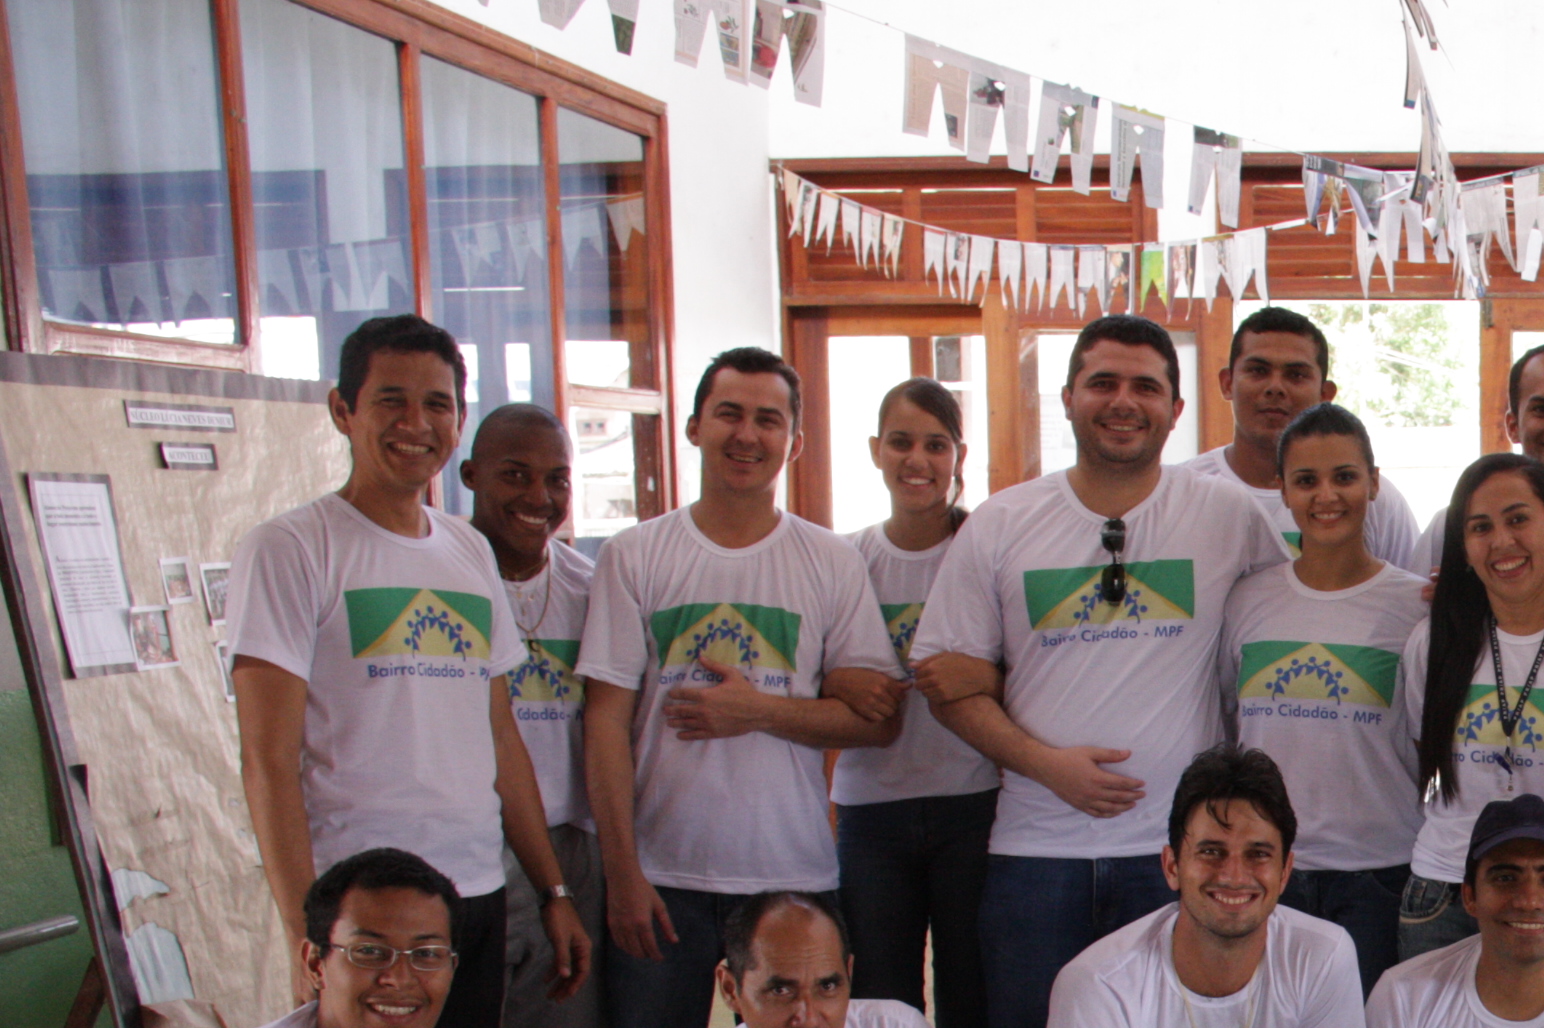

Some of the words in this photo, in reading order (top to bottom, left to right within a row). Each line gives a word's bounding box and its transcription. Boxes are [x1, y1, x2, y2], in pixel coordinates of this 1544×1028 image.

[1041, 634, 1076, 648] Bairro
[1081, 626, 1138, 642] Cidadão
[1154, 625, 1184, 638] MPF
[368, 663, 416, 678] Bairro
[418, 662, 465, 678] Cidadão
[659, 670, 686, 685] airr
[692, 668, 749, 685] Cidao
[764, 674, 791, 688] MPF
[517, 707, 565, 721] Cdadão
[1242, 703, 1273, 717] Bairro
[1278, 703, 1338, 720] Cidadão
[1353, 711, 1382, 726] MPF
[1470, 750, 1533, 768] Ciddão
